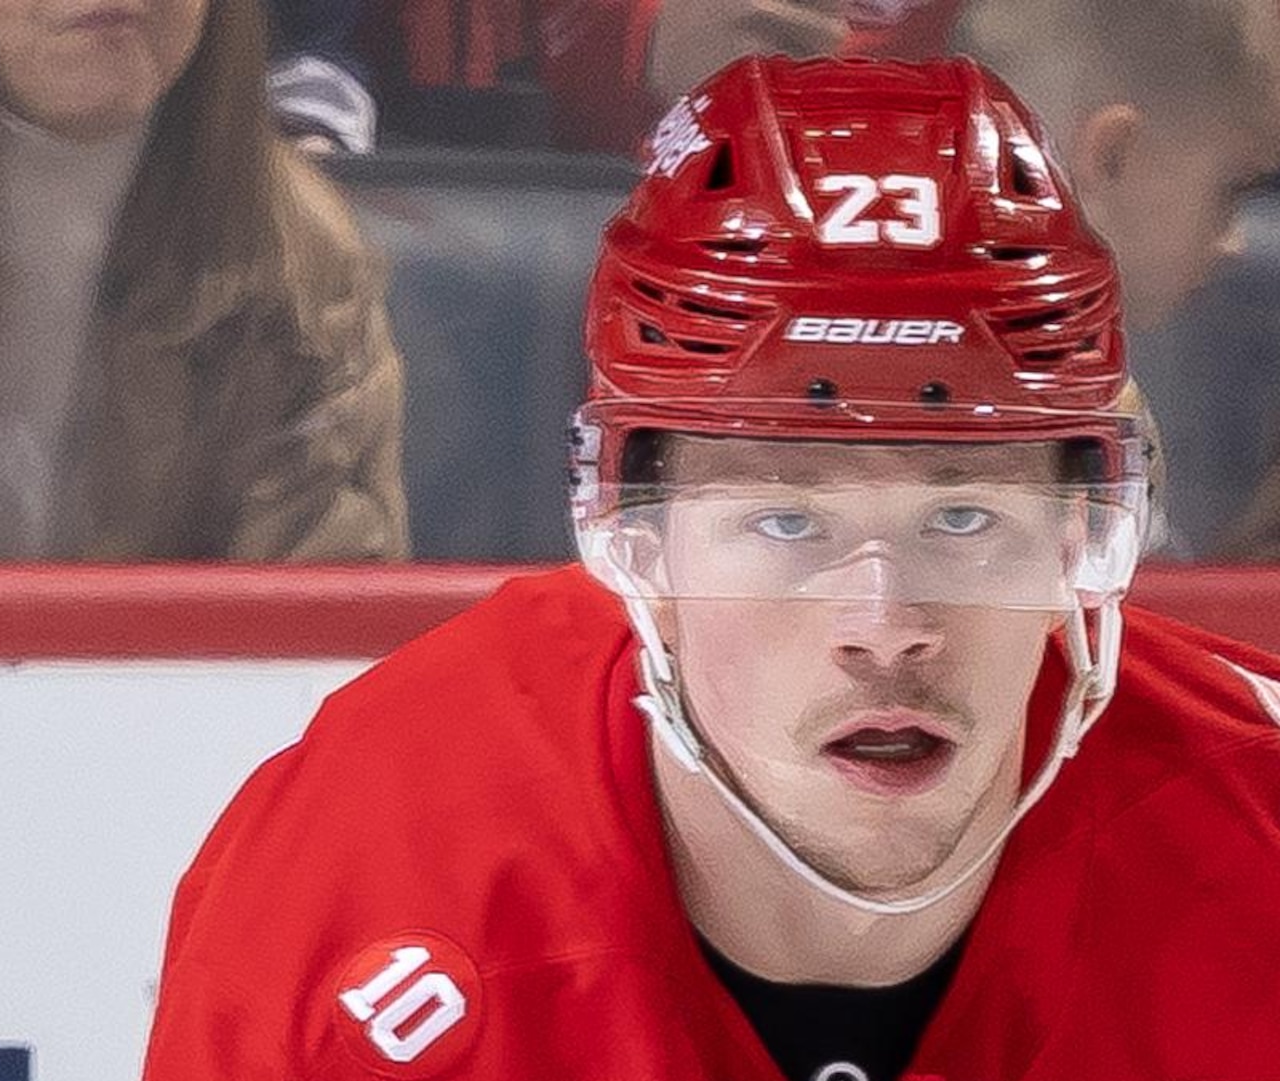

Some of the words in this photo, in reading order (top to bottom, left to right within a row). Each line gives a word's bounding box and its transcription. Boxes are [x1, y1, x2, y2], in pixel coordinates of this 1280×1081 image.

[819, 173, 942, 246] 23
[785, 316, 964, 345] BAUER
[339, 944, 467, 1062] 10
